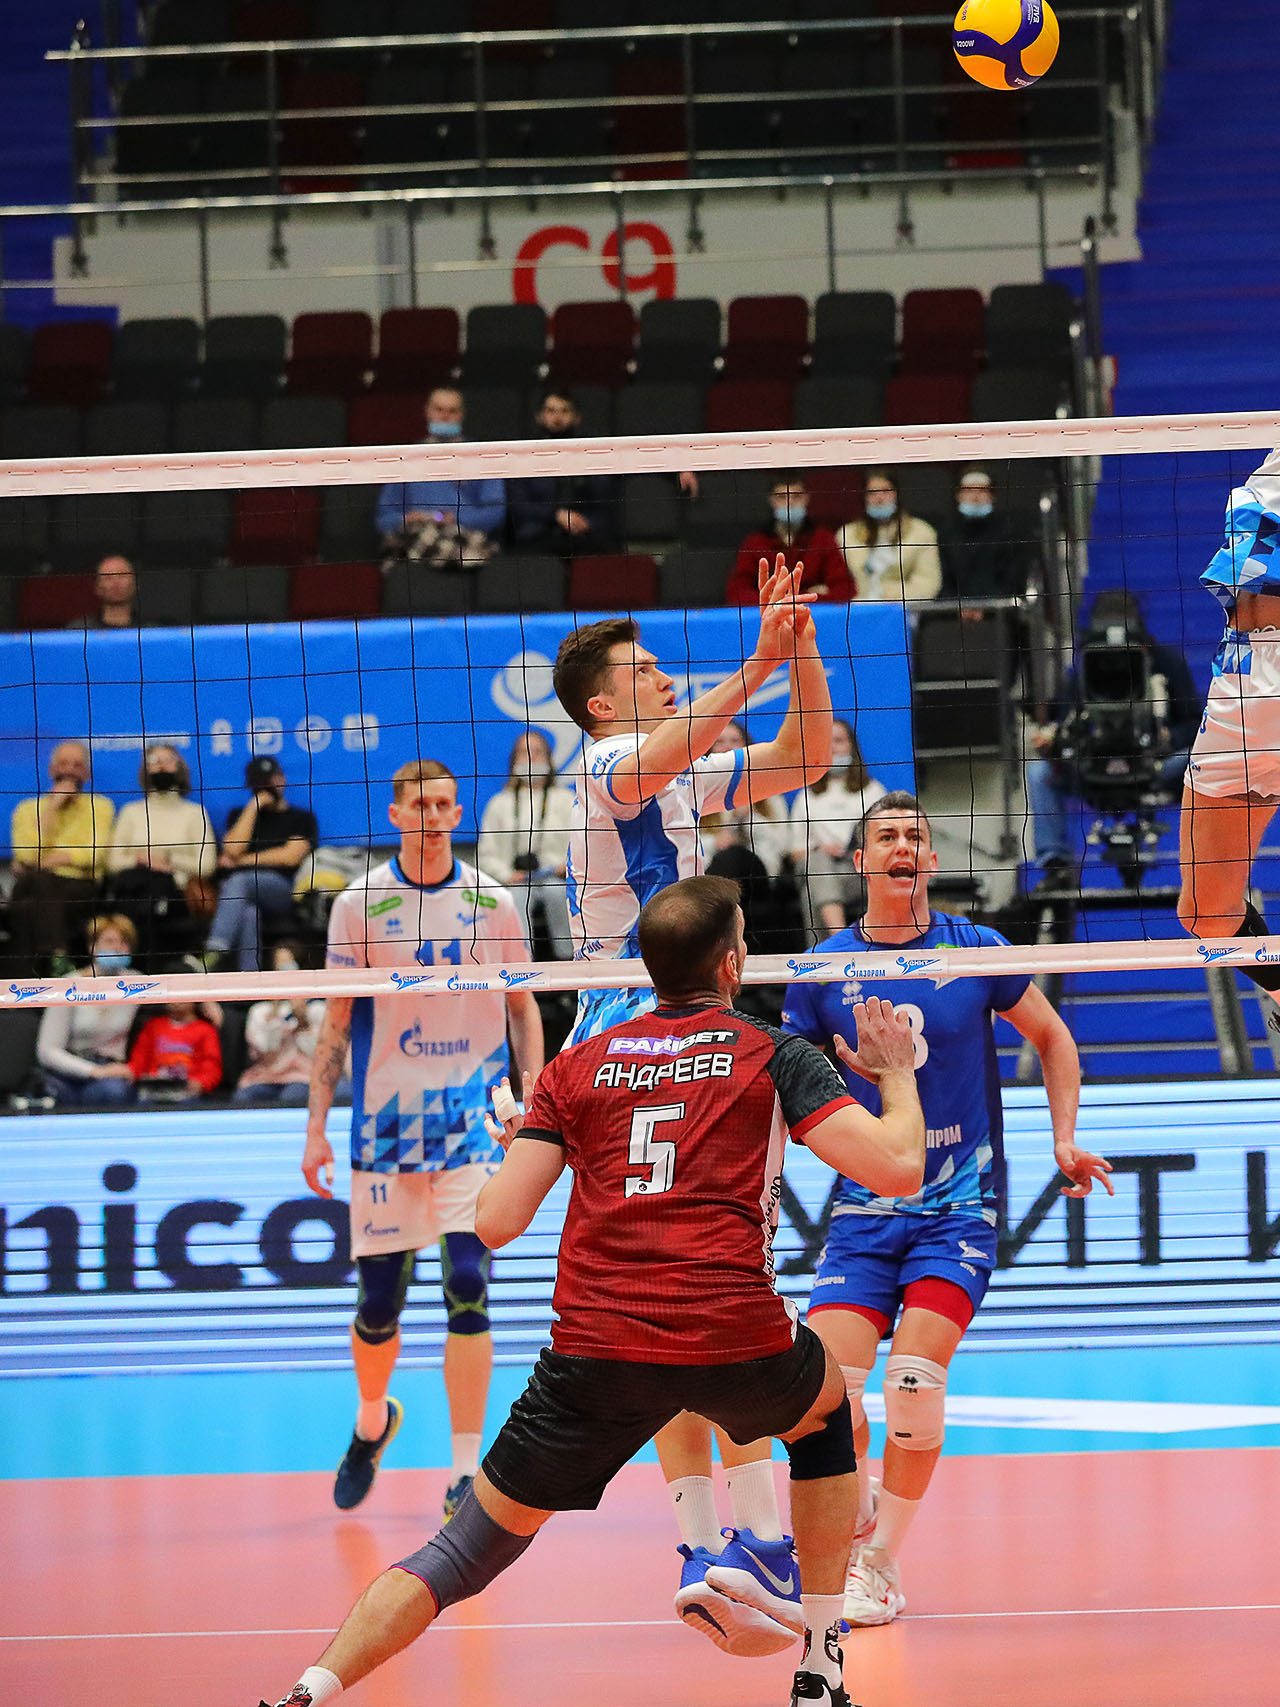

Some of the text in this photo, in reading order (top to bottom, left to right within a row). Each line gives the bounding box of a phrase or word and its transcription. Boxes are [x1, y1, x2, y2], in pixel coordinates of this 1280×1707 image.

[613, 1030, 735, 1054] PARIBET
[593, 1053, 734, 1092] АНДРЕЕВ
[926, 1124, 962, 1148] ПРОМ
[624, 1102, 686, 1199] 5
[371, 1184, 387, 1204] 11
